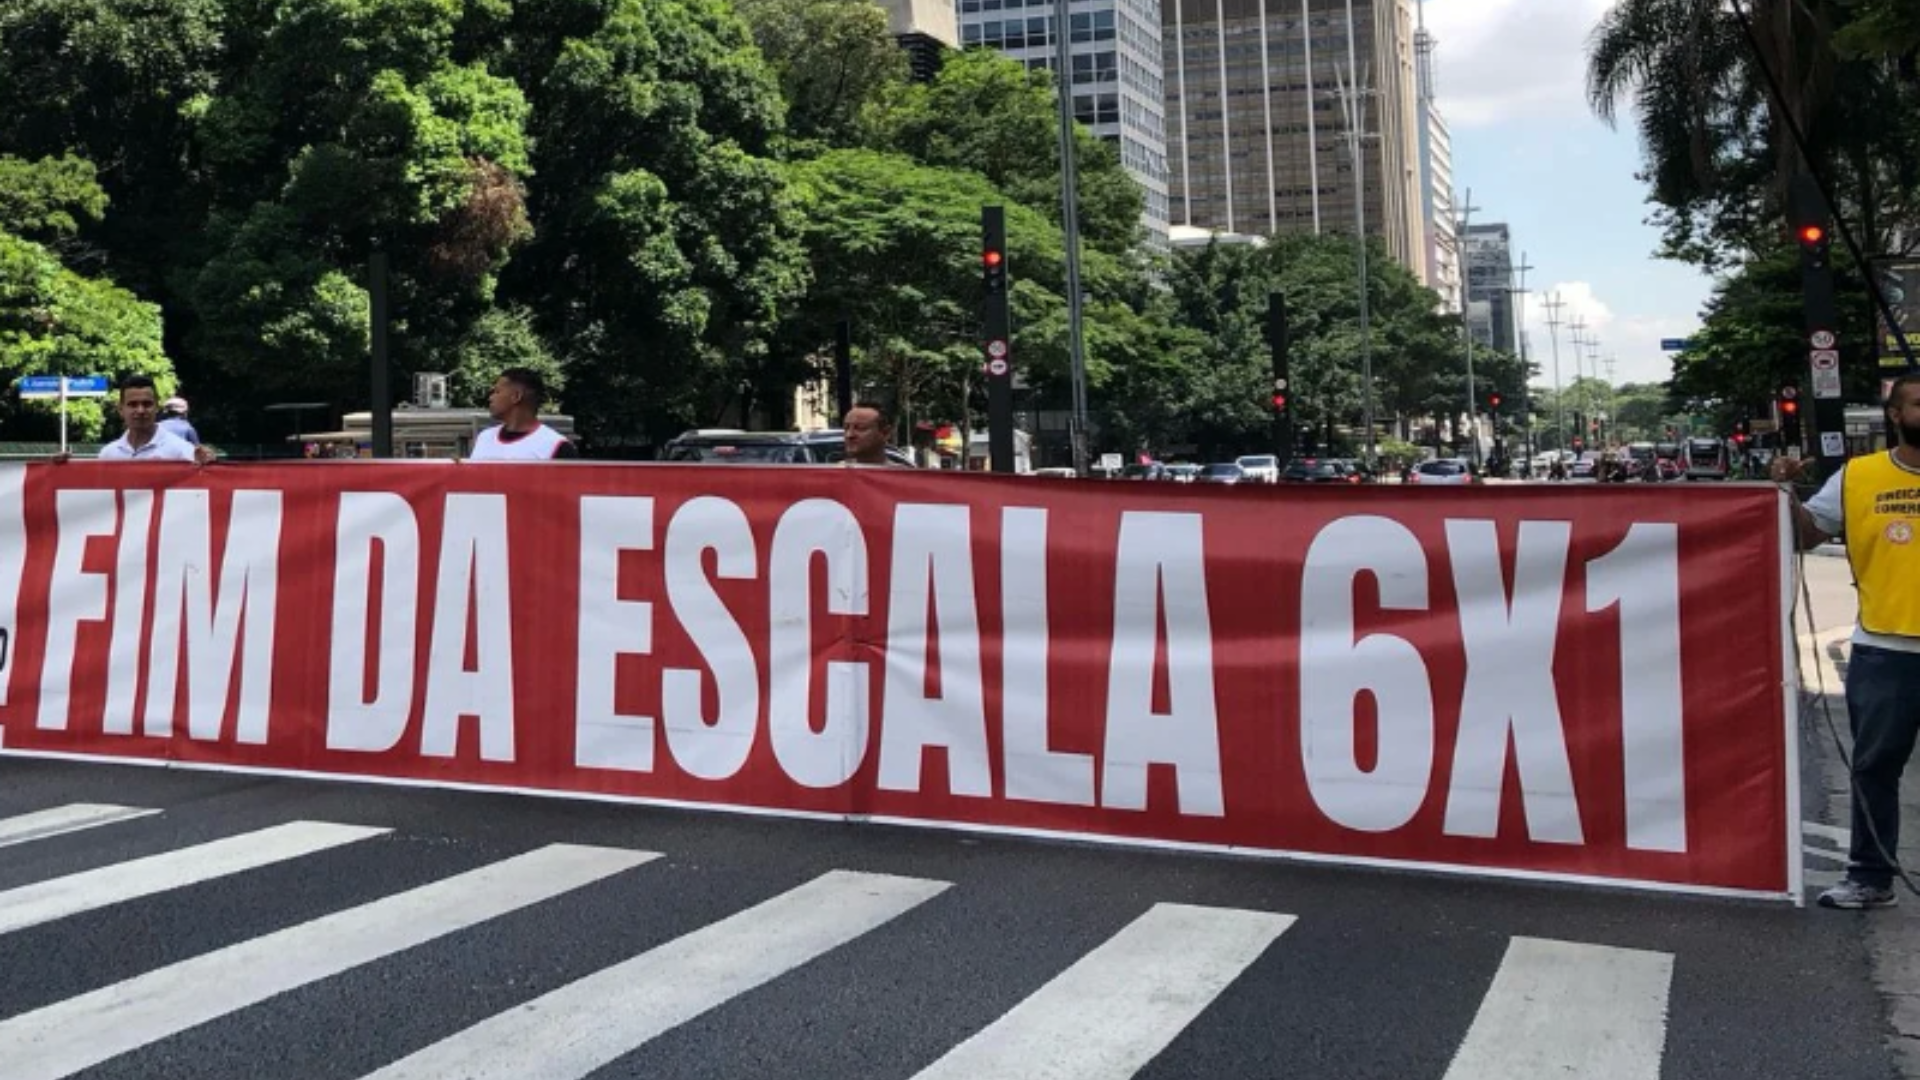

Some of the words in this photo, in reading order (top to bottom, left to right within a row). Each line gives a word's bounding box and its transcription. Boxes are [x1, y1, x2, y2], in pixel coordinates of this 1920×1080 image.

[36, 488, 284, 745] FIM
[326, 491, 516, 762] DA
[574, 494, 1225, 817] ESCALA
[1298, 514, 1687, 853] 6X1
